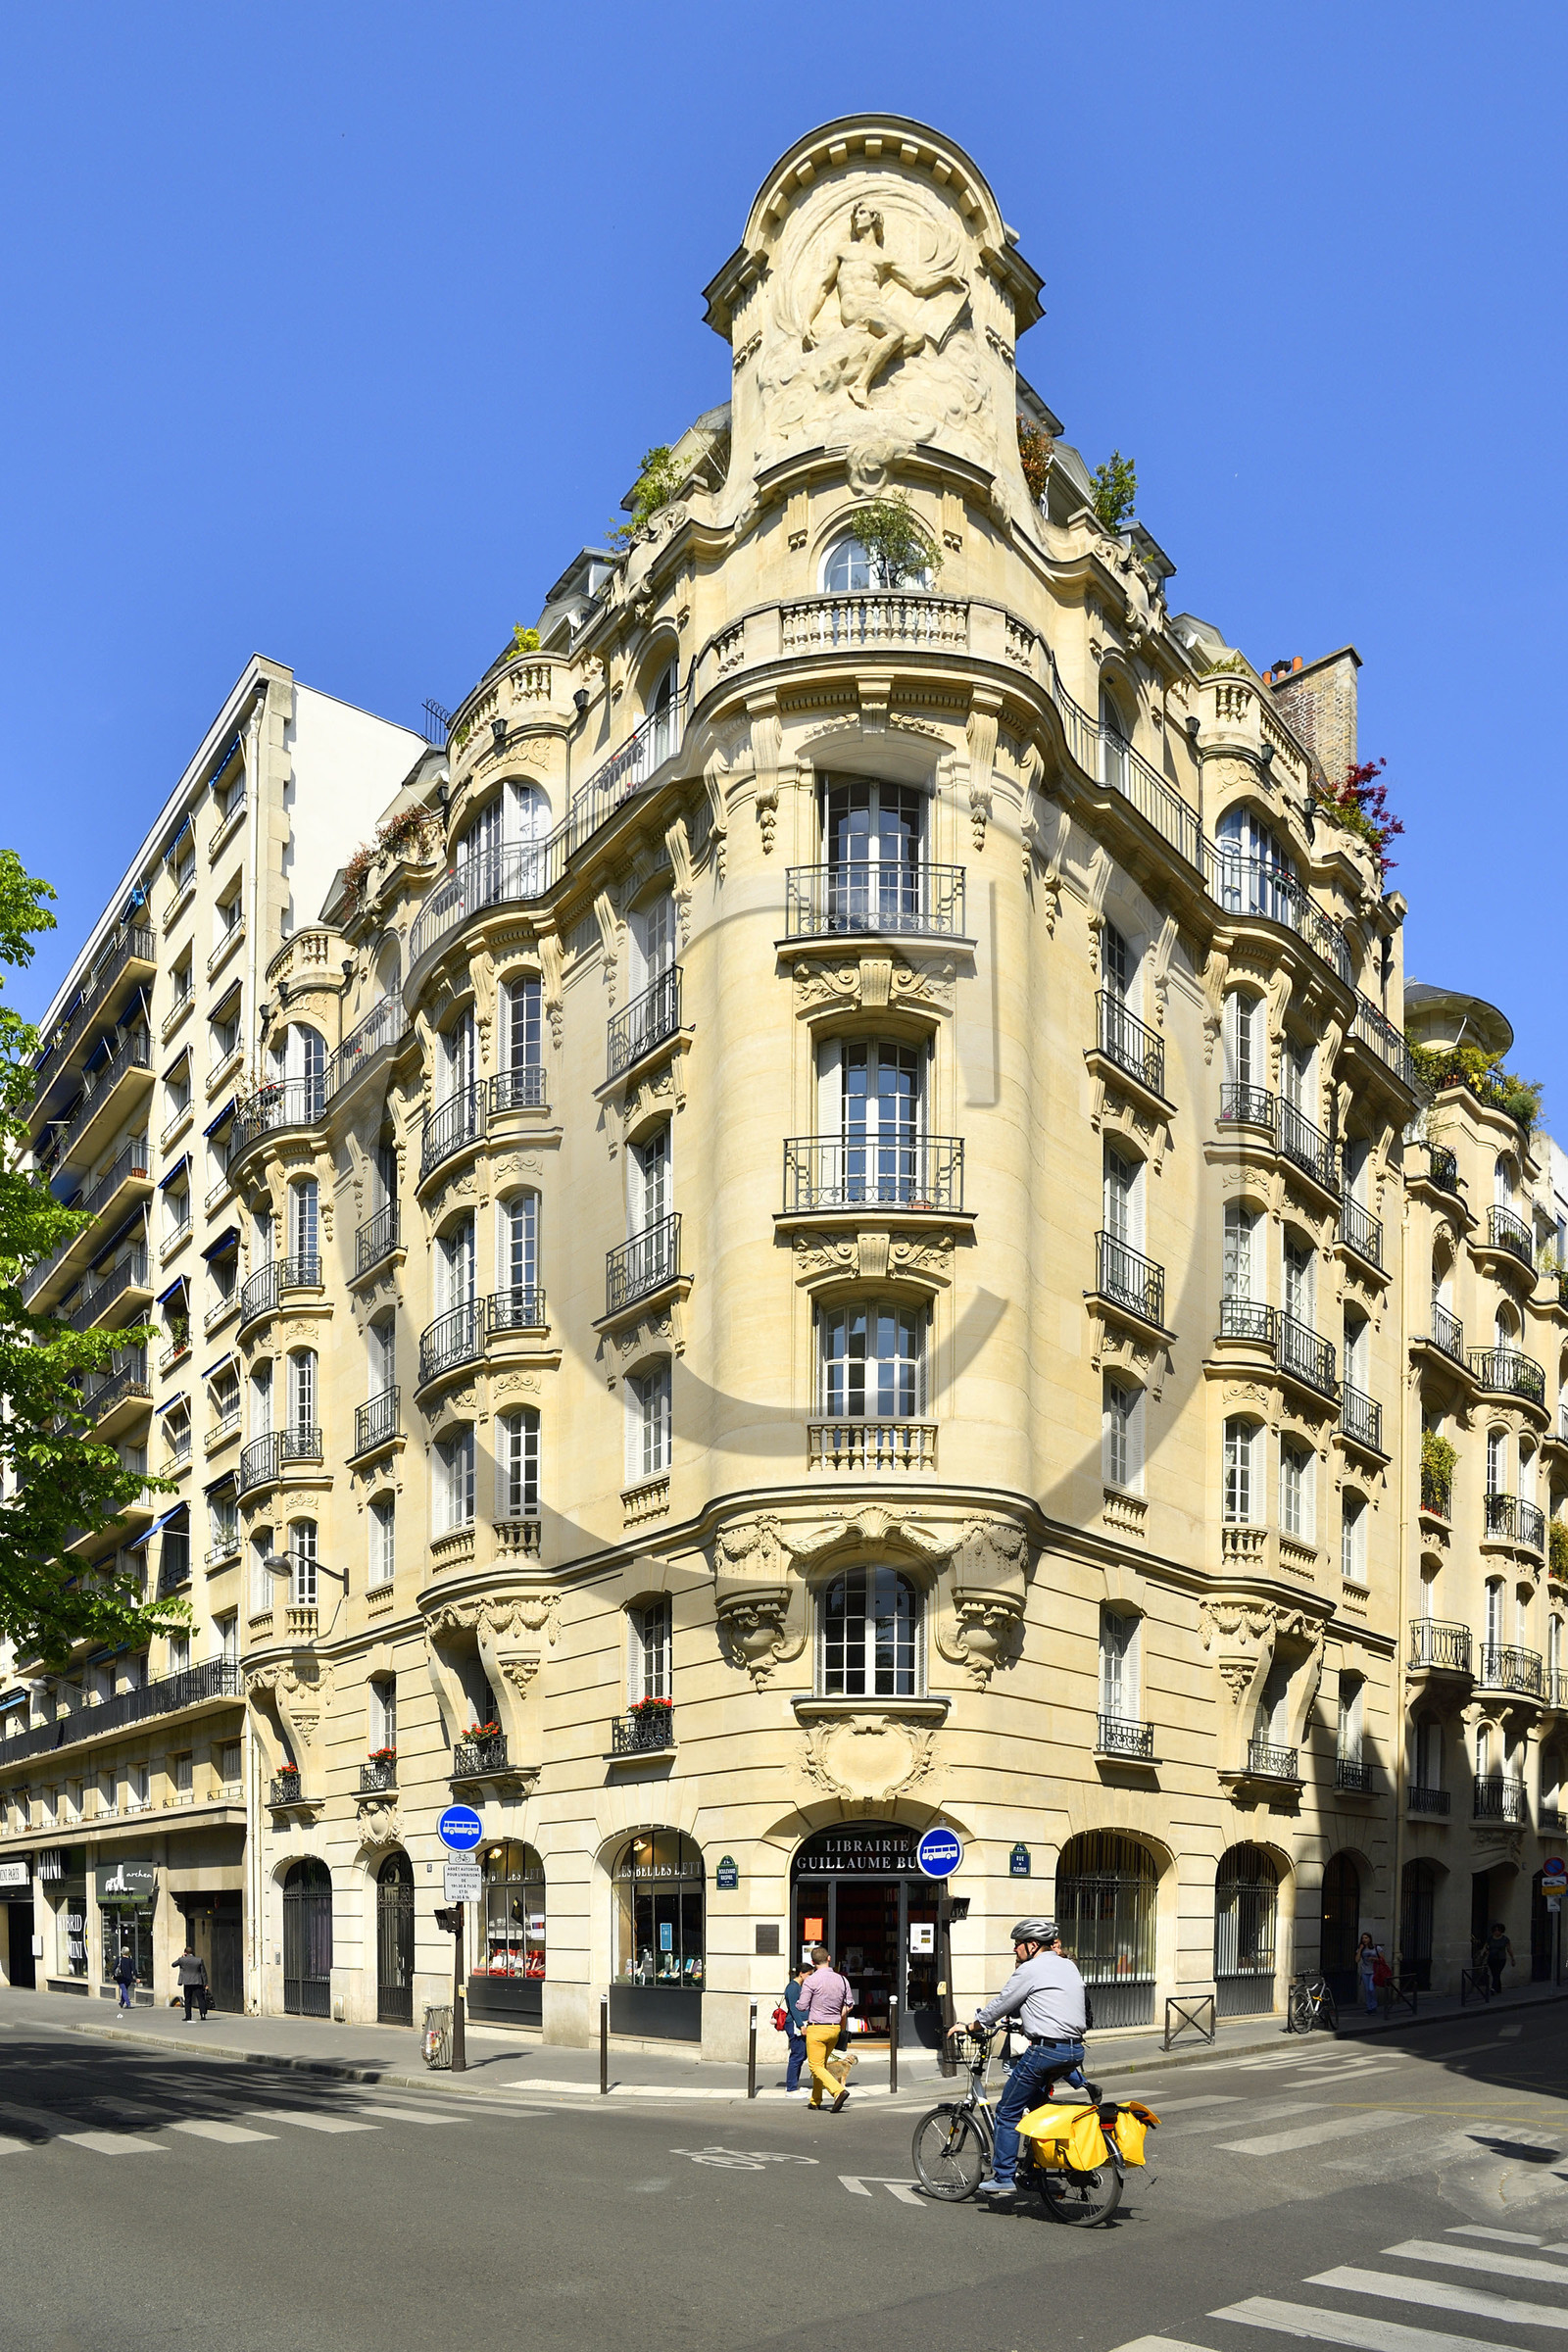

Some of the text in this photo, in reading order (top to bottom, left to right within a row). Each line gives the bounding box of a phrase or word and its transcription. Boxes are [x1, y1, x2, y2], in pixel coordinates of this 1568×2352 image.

[826, 1839, 909, 1852] LIBRAIRIE
[37, 1849, 62, 1880] MINI
[636, 1862, 672, 1878] BELLES
[797, 1856, 921, 1870] GUILLAUME BU
[125, 1869, 153, 1879] archea
[57, 1914, 82, 1932] HYBRID
[1184, 2052, 1412, 2072] BUS
